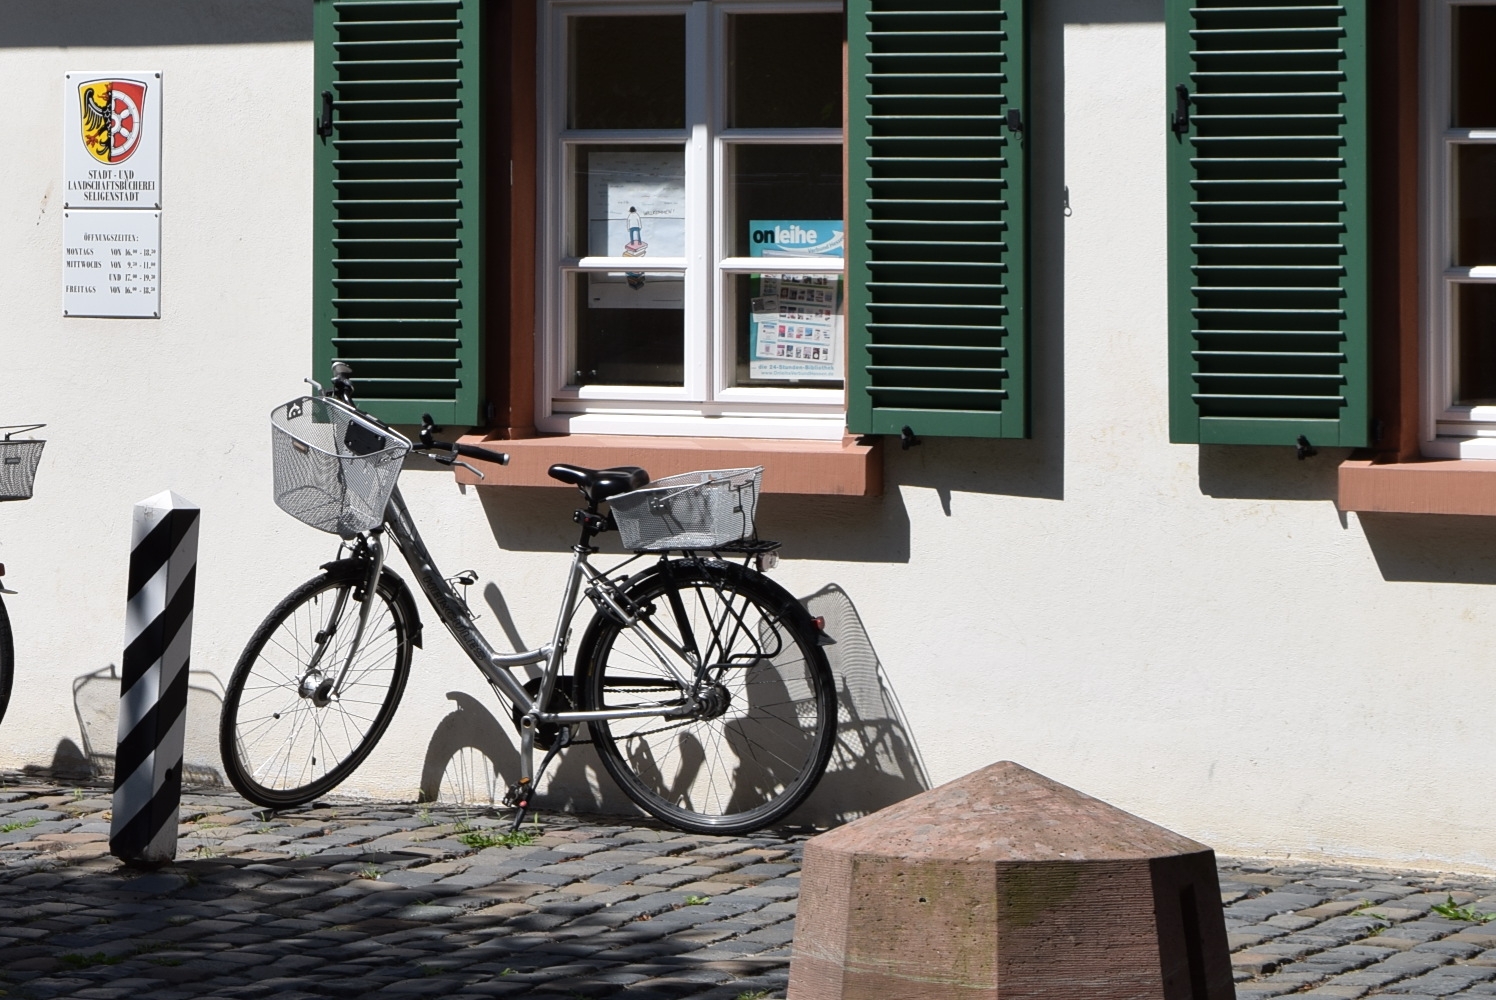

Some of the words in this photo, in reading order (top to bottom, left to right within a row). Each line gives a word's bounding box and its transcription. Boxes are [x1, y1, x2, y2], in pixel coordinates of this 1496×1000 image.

[88, 169, 112, 180] STADT
[118, 169, 135, 180] UND
[68, 179, 155, 191] LANDSCHAFTSBÜCHEREI
[83, 191, 139, 202] SELIGENSTADT
[752, 225, 818, 244] onleihe
[66, 247, 94, 256] MONTAGS
[110, 248, 122, 256] VON
[66, 260, 102, 268] MITTWOCHS
[110, 260, 122, 268] VON
[108, 273, 122, 281] UND
[65, 285, 96, 293] FREITAGS
[109, 286, 121, 294] VON
